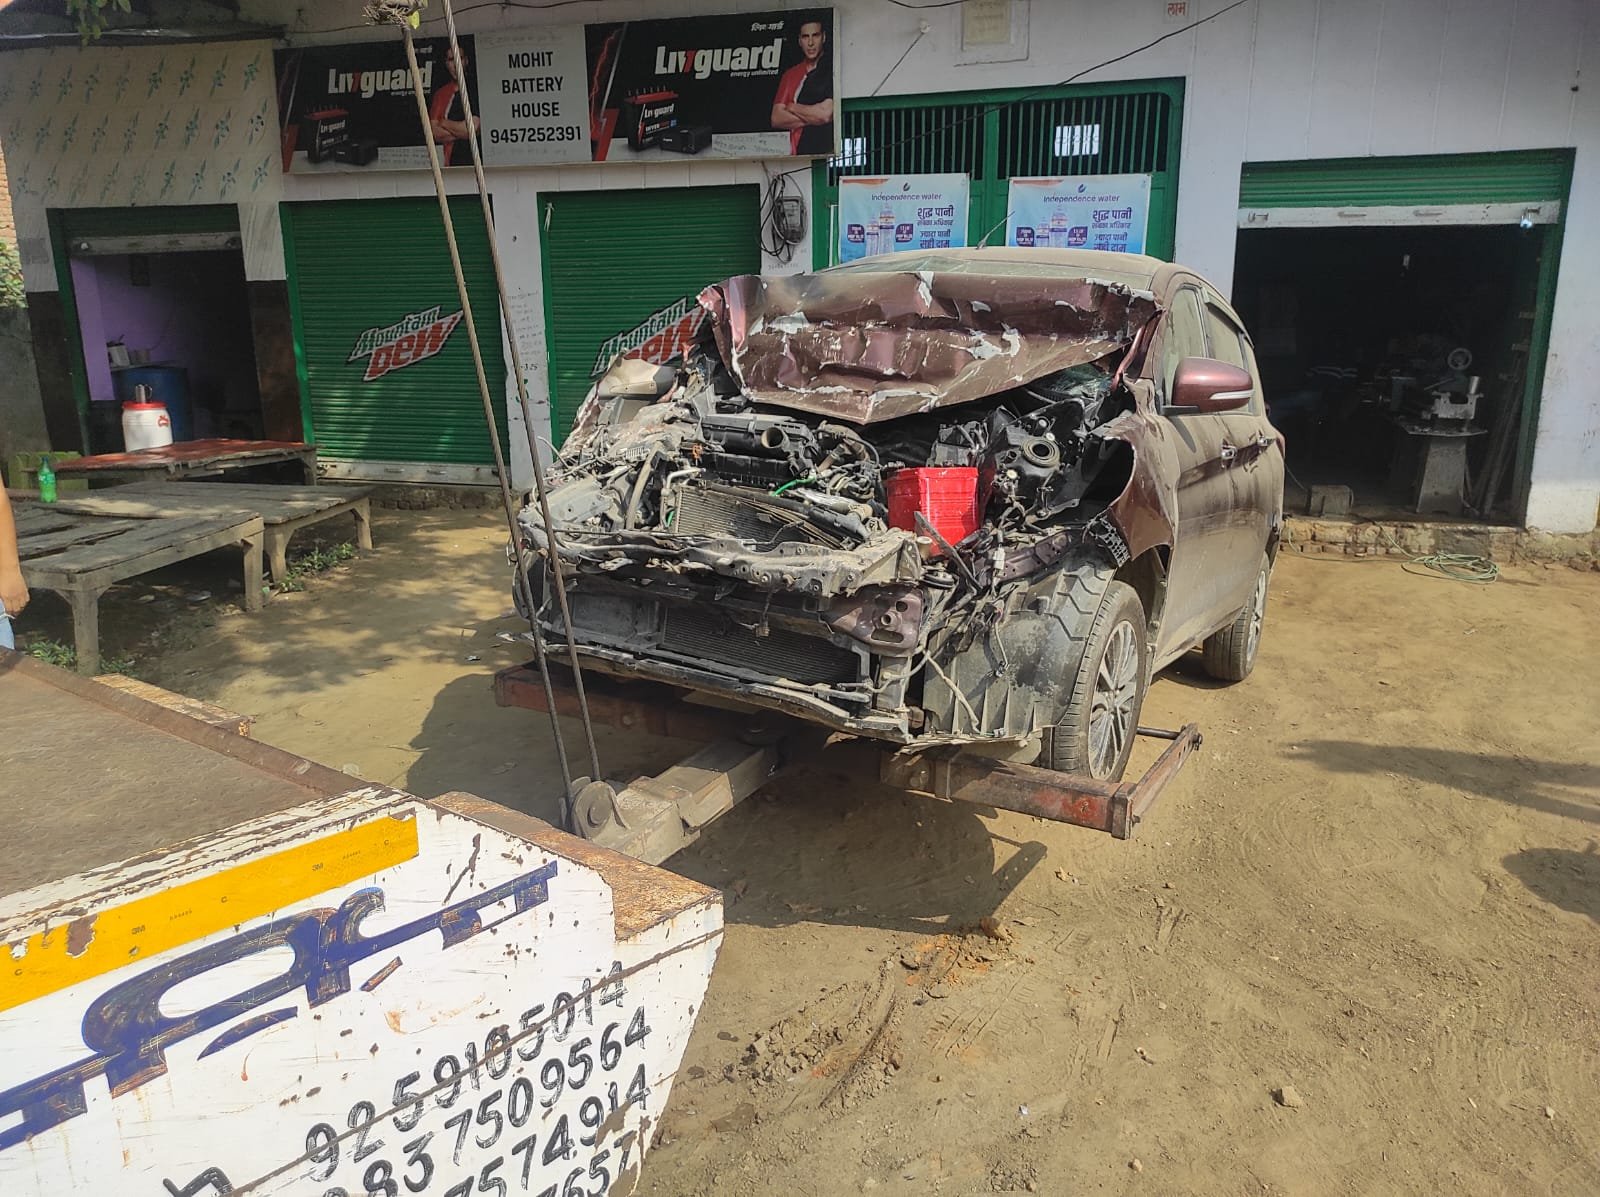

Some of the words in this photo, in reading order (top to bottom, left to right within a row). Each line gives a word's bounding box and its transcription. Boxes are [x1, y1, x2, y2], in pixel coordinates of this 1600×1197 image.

[508, 51, 554, 69] MOHIT
[655, 38, 782, 80] Livguard
[501, 76, 563, 94] BATTERY
[512, 102, 560, 118] HOUSE
[490, 126, 581, 144] 9457252391
[871, 192, 920, 201] Independence
[921, 192, 942, 201] water
[1043, 195, 1096, 203] Independence
[1098, 194, 1120, 202] water
[917, 207, 933, 220] शुद्ध
[935, 204, 954, 217] पानी
[1092, 209, 1109, 222] शुद्ध
[1111, 207, 1132, 220] पानी
[937, 229, 951, 237] पानी
[1112, 231, 1127, 241] पानी
[322, 1006, 652, 1197] 837509564
